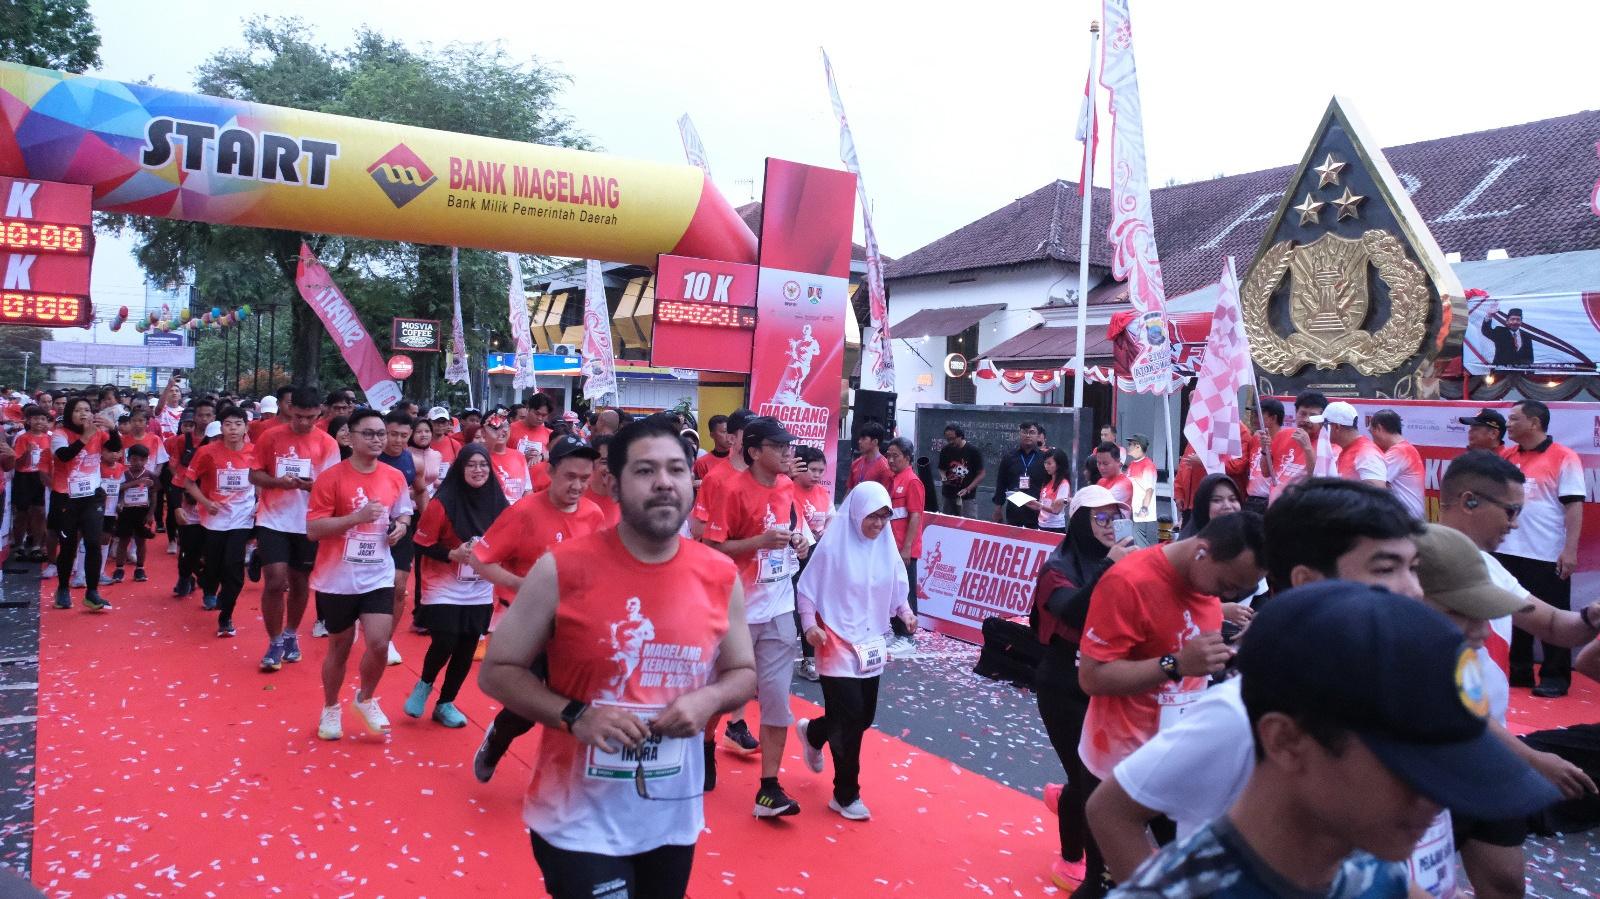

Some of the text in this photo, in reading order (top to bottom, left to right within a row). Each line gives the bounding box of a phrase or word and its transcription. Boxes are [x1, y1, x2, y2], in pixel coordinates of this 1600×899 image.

[142, 119, 337, 187] START
[450, 156, 620, 209] BANK MAGELANG
[448, 195, 617, 225] Bank Milik Pemerintah Daerah
[0, 221, 82, 251] 0:00
[683, 271, 733, 302] 10 K
[401, 322, 433, 330] MOSVIA
[402, 329, 432, 337] COFFEE
[759, 403, 829, 424] MAGELANG
[785, 422, 827, 439] NGSAAN
[965, 538, 1052, 582] MAGELA
[954, 603, 966, 614] FUN
[967, 606, 980, 619] RUN
[643, 643, 702, 661] MAGELANG
[640, 672, 663, 688] RUN
